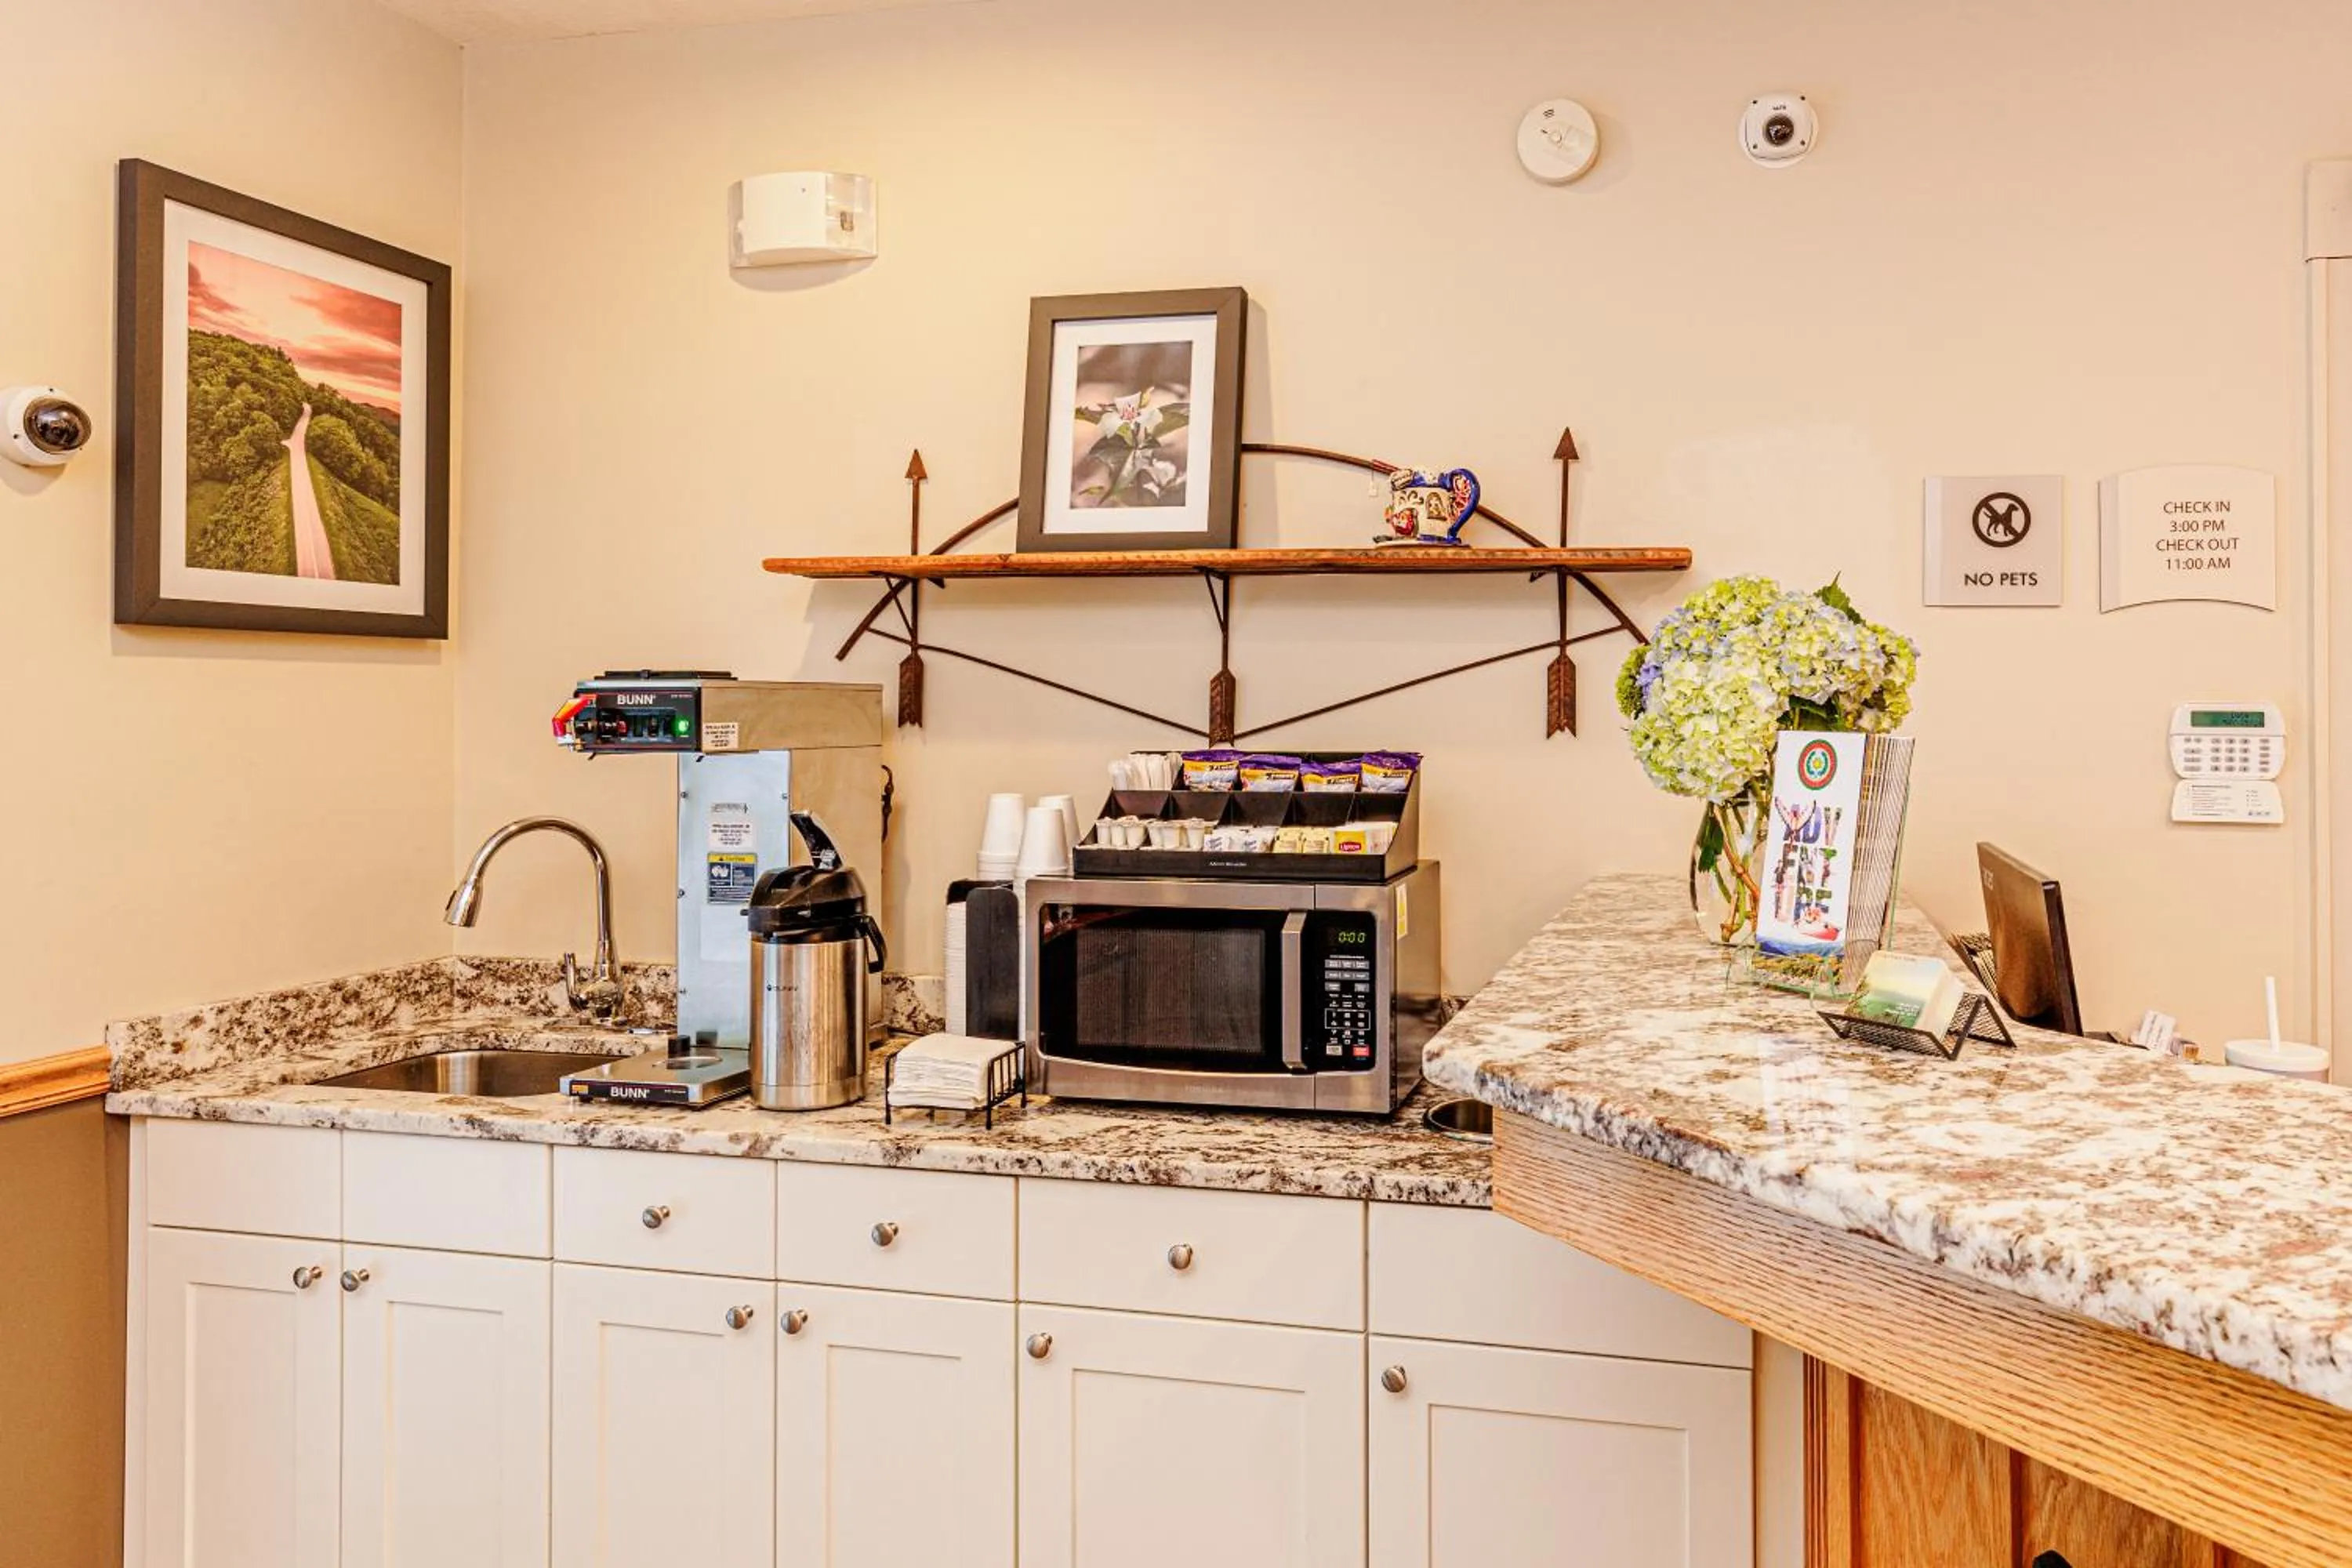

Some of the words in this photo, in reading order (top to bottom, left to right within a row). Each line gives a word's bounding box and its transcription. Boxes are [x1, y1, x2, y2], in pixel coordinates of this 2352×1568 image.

[2164, 502, 2212, 514] CHECK
[2216, 501, 2230, 512] IN
[2170, 521, 2198, 532] 3:00
[2203, 520, 2224, 532] PM
[2156, 539, 2204, 551] CHECK
[2208, 537, 2239, 550] OUT
[2165, 558, 2203, 570] 11:00
[2208, 557, 2230, 569] AM
[1964, 572, 1994, 586] NO
[2000, 572, 2038, 586] PETS
[616, 694, 654, 705] BUNN
[610, 1087, 648, 1098] BUNN
